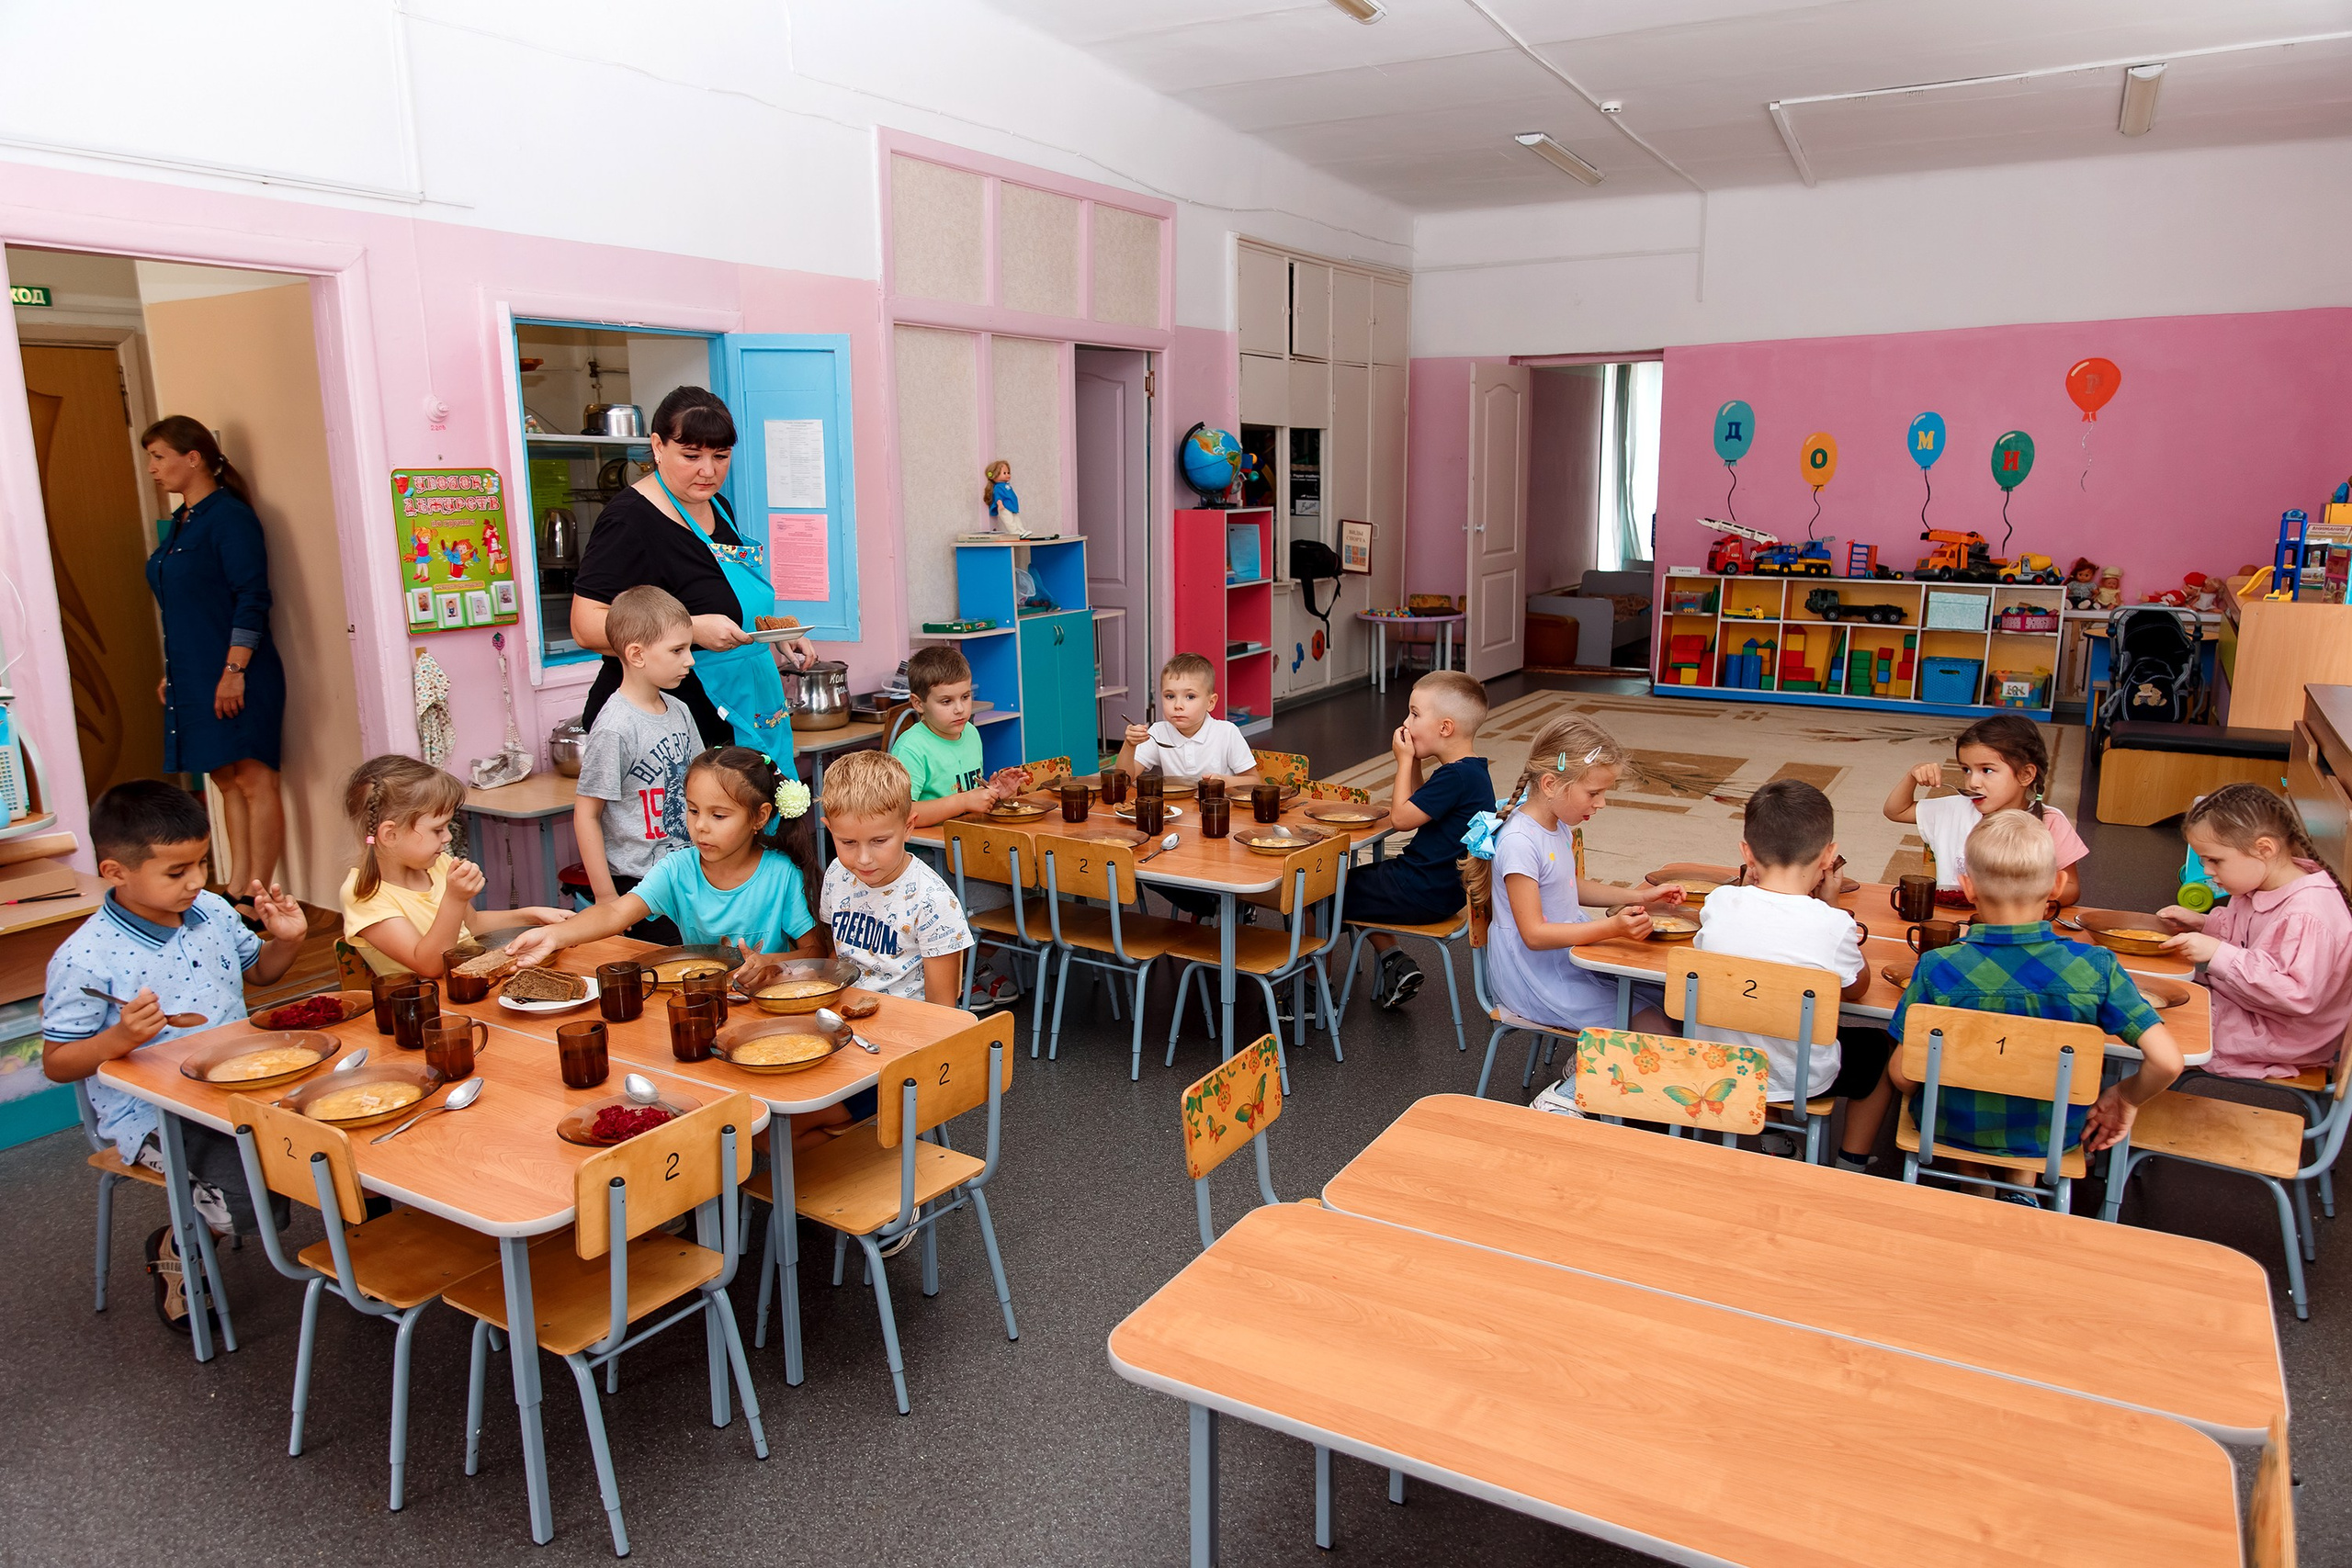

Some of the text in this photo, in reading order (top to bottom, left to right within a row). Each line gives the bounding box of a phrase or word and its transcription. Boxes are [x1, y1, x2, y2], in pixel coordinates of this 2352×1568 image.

[1725, 422, 1742, 442] Д
[1917, 430, 1934, 450] М
[1810, 448, 1828, 468] О
[2002, 451, 2020, 471] И
[413, 474, 484, 493] УГОЛОК
[403, 495, 501, 517] ДЕЖУРСТВ
[983, 840, 990, 854] 2
[1080, 858, 1089, 874] 2
[1316, 857, 1323, 873] 2
[832, 911, 898, 955] FREEDOM
[1742, 979, 1758, 999] 2
[1996, 1036, 2007, 1055] 1
[938, 1062, 951, 1086] 2
[283, 1137, 298, 1159] 2
[664, 1152, 680, 1181] 2
